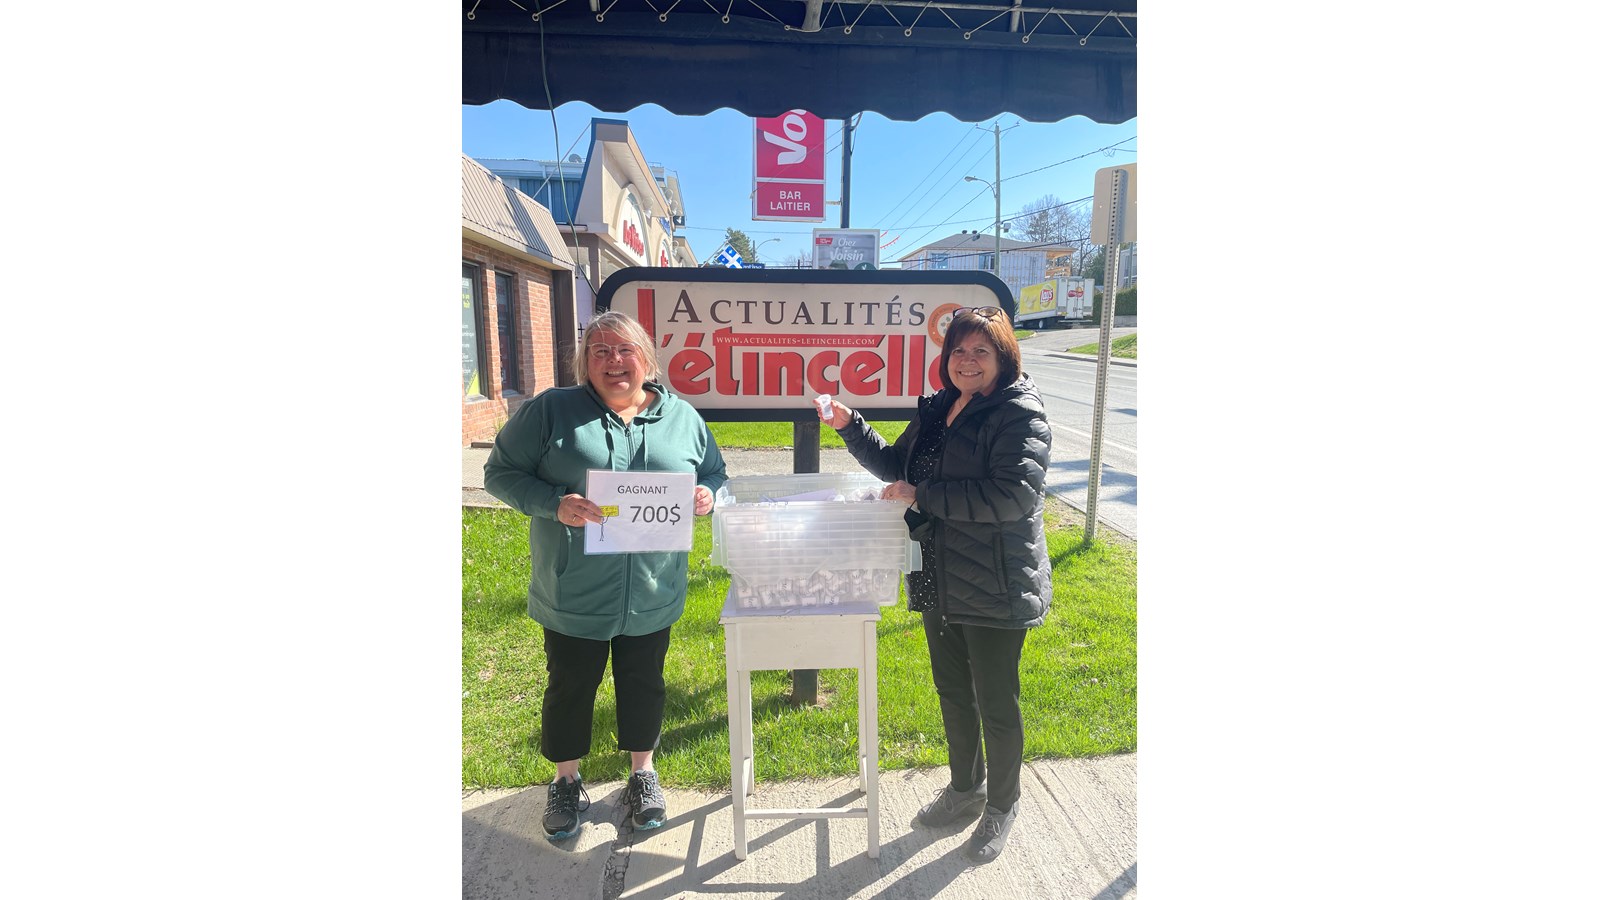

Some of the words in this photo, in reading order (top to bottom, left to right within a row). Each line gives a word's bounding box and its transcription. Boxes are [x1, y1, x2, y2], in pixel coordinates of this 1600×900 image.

[763, 109, 807, 165] Vo
[779, 190, 802, 200] BAR
[770, 201, 811, 211] LAITIER
[830, 247, 865, 261] Voisin
[667, 289, 925, 326] ACTUALITÉS
[637, 288, 945, 396] 'étincell
[617, 485, 668, 494] GAGNANT
[629, 504, 681, 525] 700$
